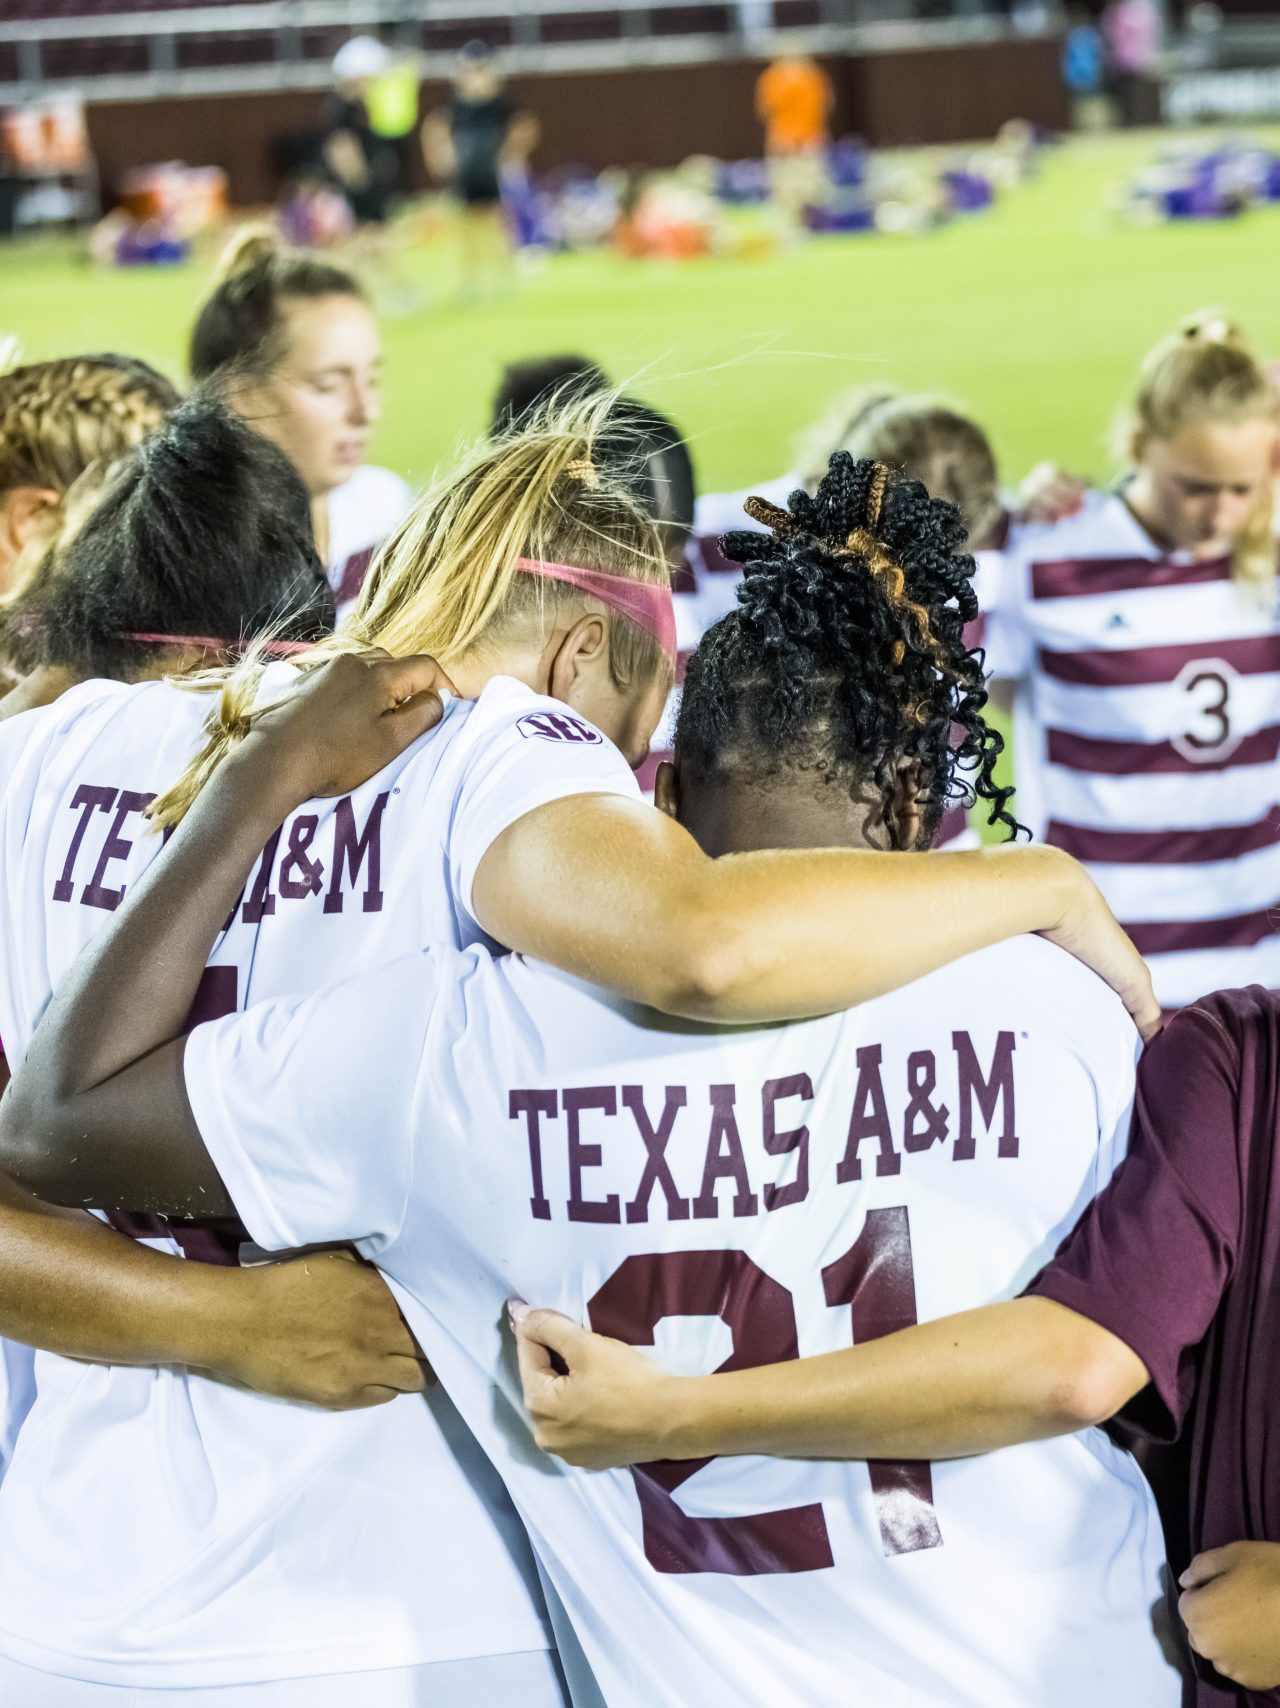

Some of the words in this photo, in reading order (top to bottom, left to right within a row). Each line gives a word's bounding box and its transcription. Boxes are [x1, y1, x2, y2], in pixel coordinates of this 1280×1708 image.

[522, 712, 598, 741] SEC
[1176, 664, 1234, 757] 3
[509, 1072, 814, 1224] TEXAS
[837, 1030, 1020, 1184] A&M
[586, 1204, 944, 1576] 21
